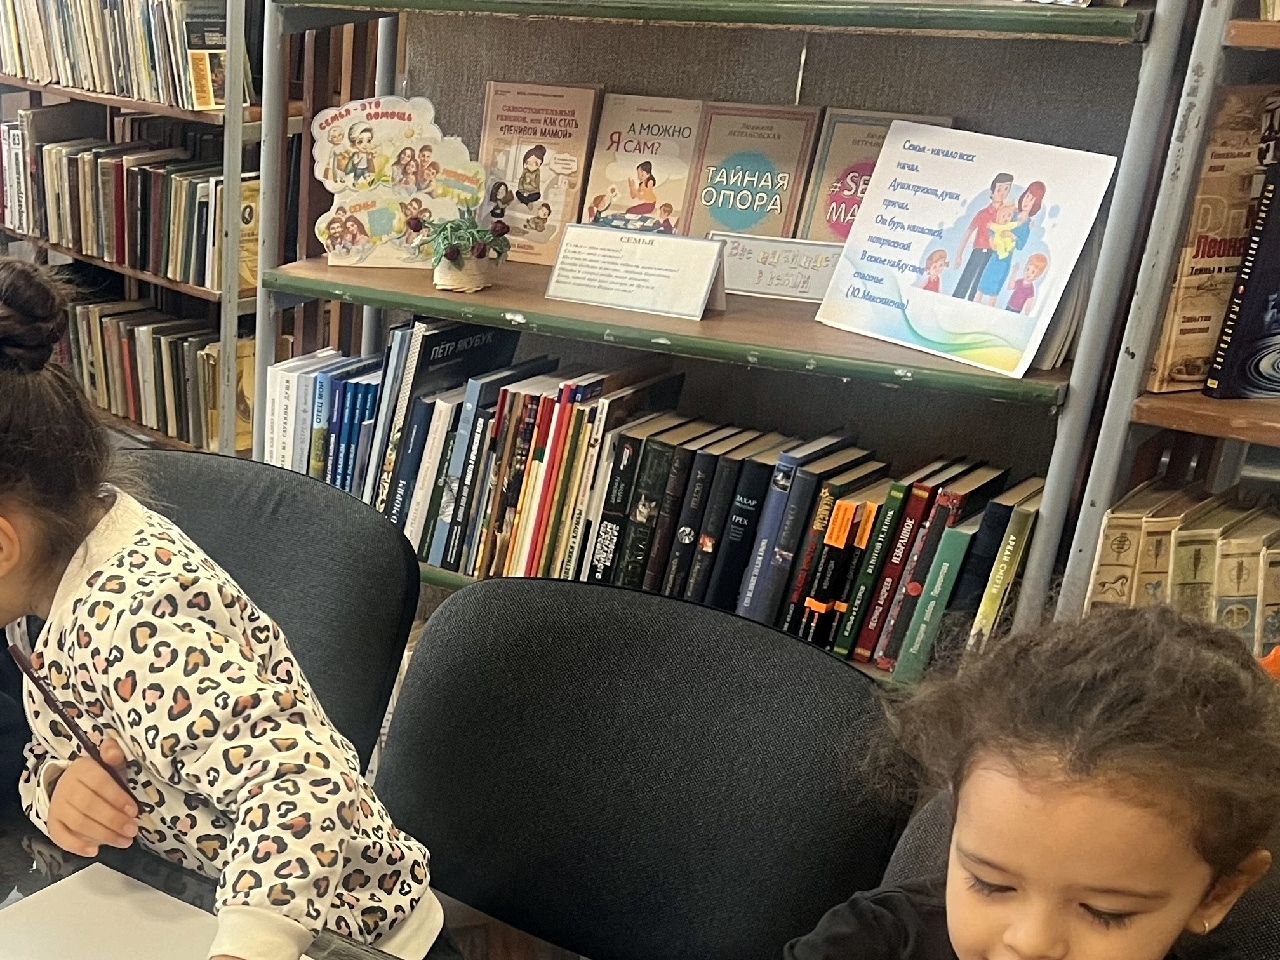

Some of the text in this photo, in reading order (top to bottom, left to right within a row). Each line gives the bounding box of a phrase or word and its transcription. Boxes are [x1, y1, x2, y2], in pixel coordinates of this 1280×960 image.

[543, 116, 558, 127] КАК
[558, 118, 579, 129] СТАТЬ
[626, 122, 693, 139] А МОЖНО
[606, 131, 662, 155] Я САМ?
[705, 165, 791, 191] ТАЙНАЯ
[828, 170, 873, 198] #SE
[701, 186, 783, 214] ОПОРА
[429, 340, 456, 361] ПЁТР
[891, 516, 915, 565] ИЗБРАННОЕ
